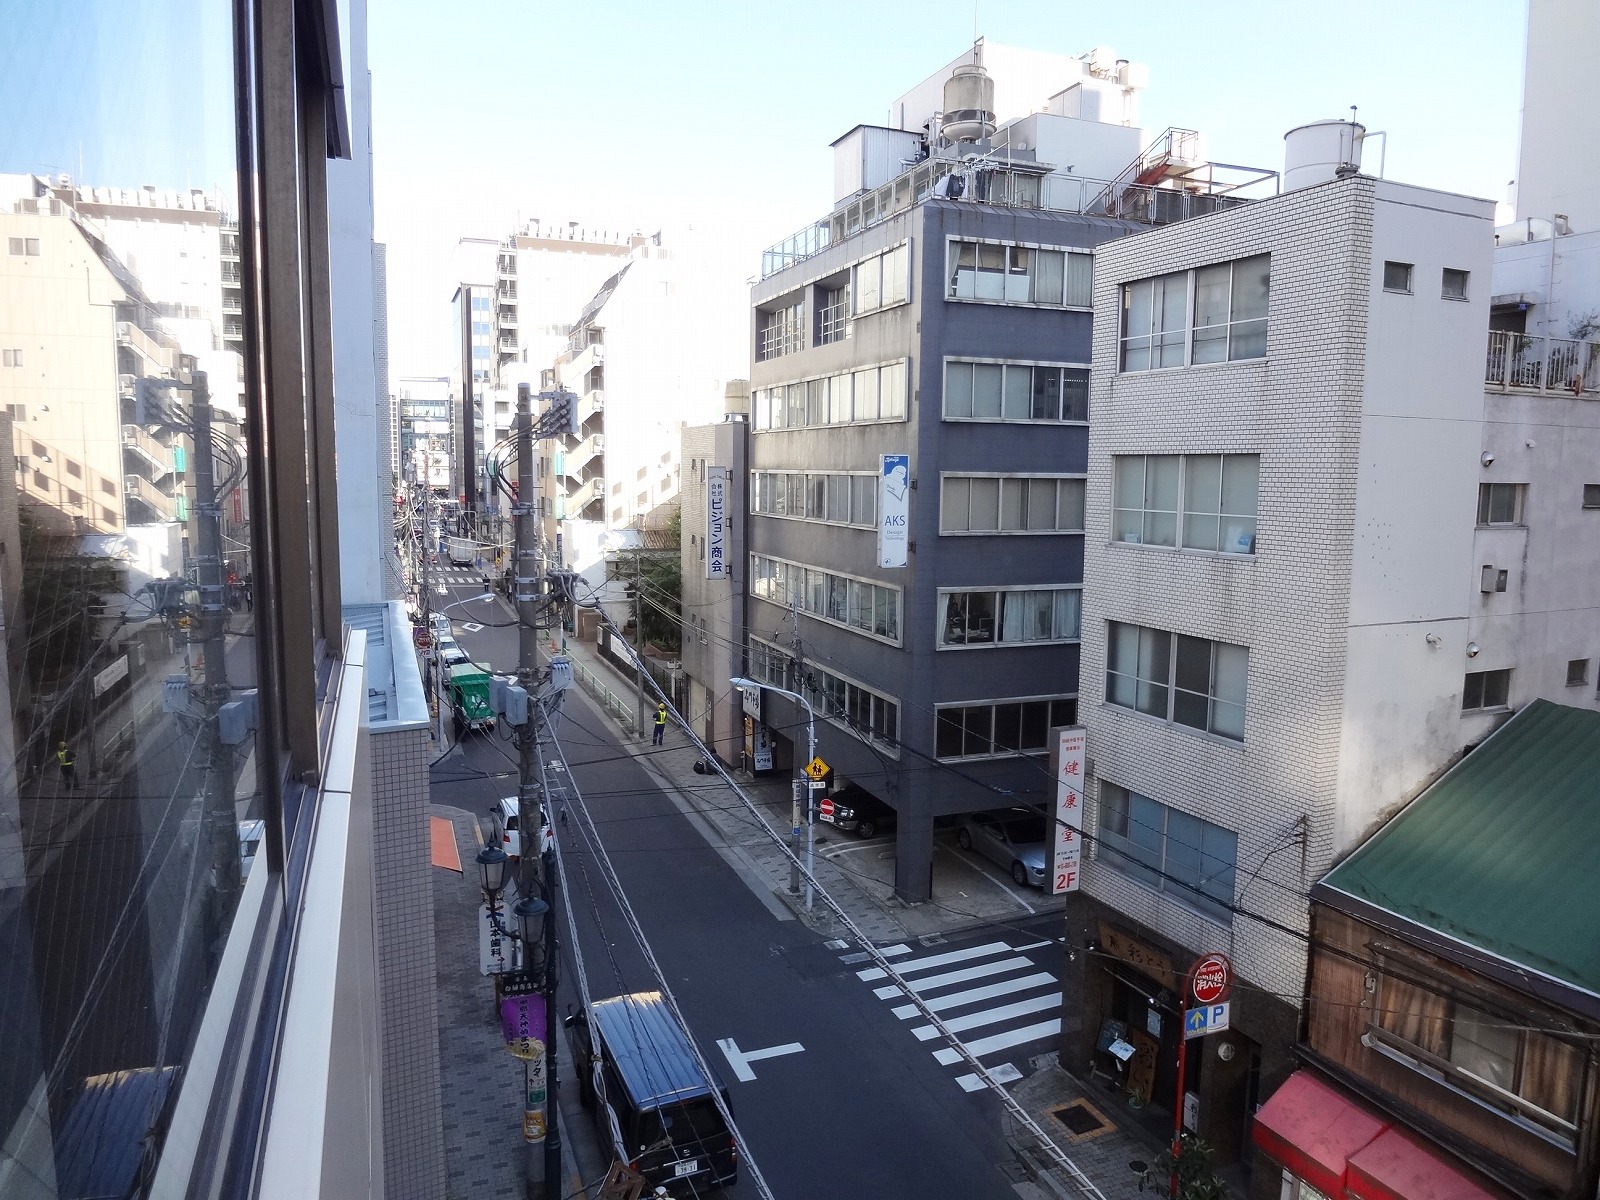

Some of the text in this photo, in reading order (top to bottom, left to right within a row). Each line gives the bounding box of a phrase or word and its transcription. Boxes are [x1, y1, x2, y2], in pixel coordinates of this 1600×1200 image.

[884, 515, 906, 527] AKS
[711, 498, 723, 573] ピジョン商会
[1056, 872, 1076, 890] 2F
[1196, 971, 1223, 991] 消火栓
[1213, 1005, 1225, 1024] P
